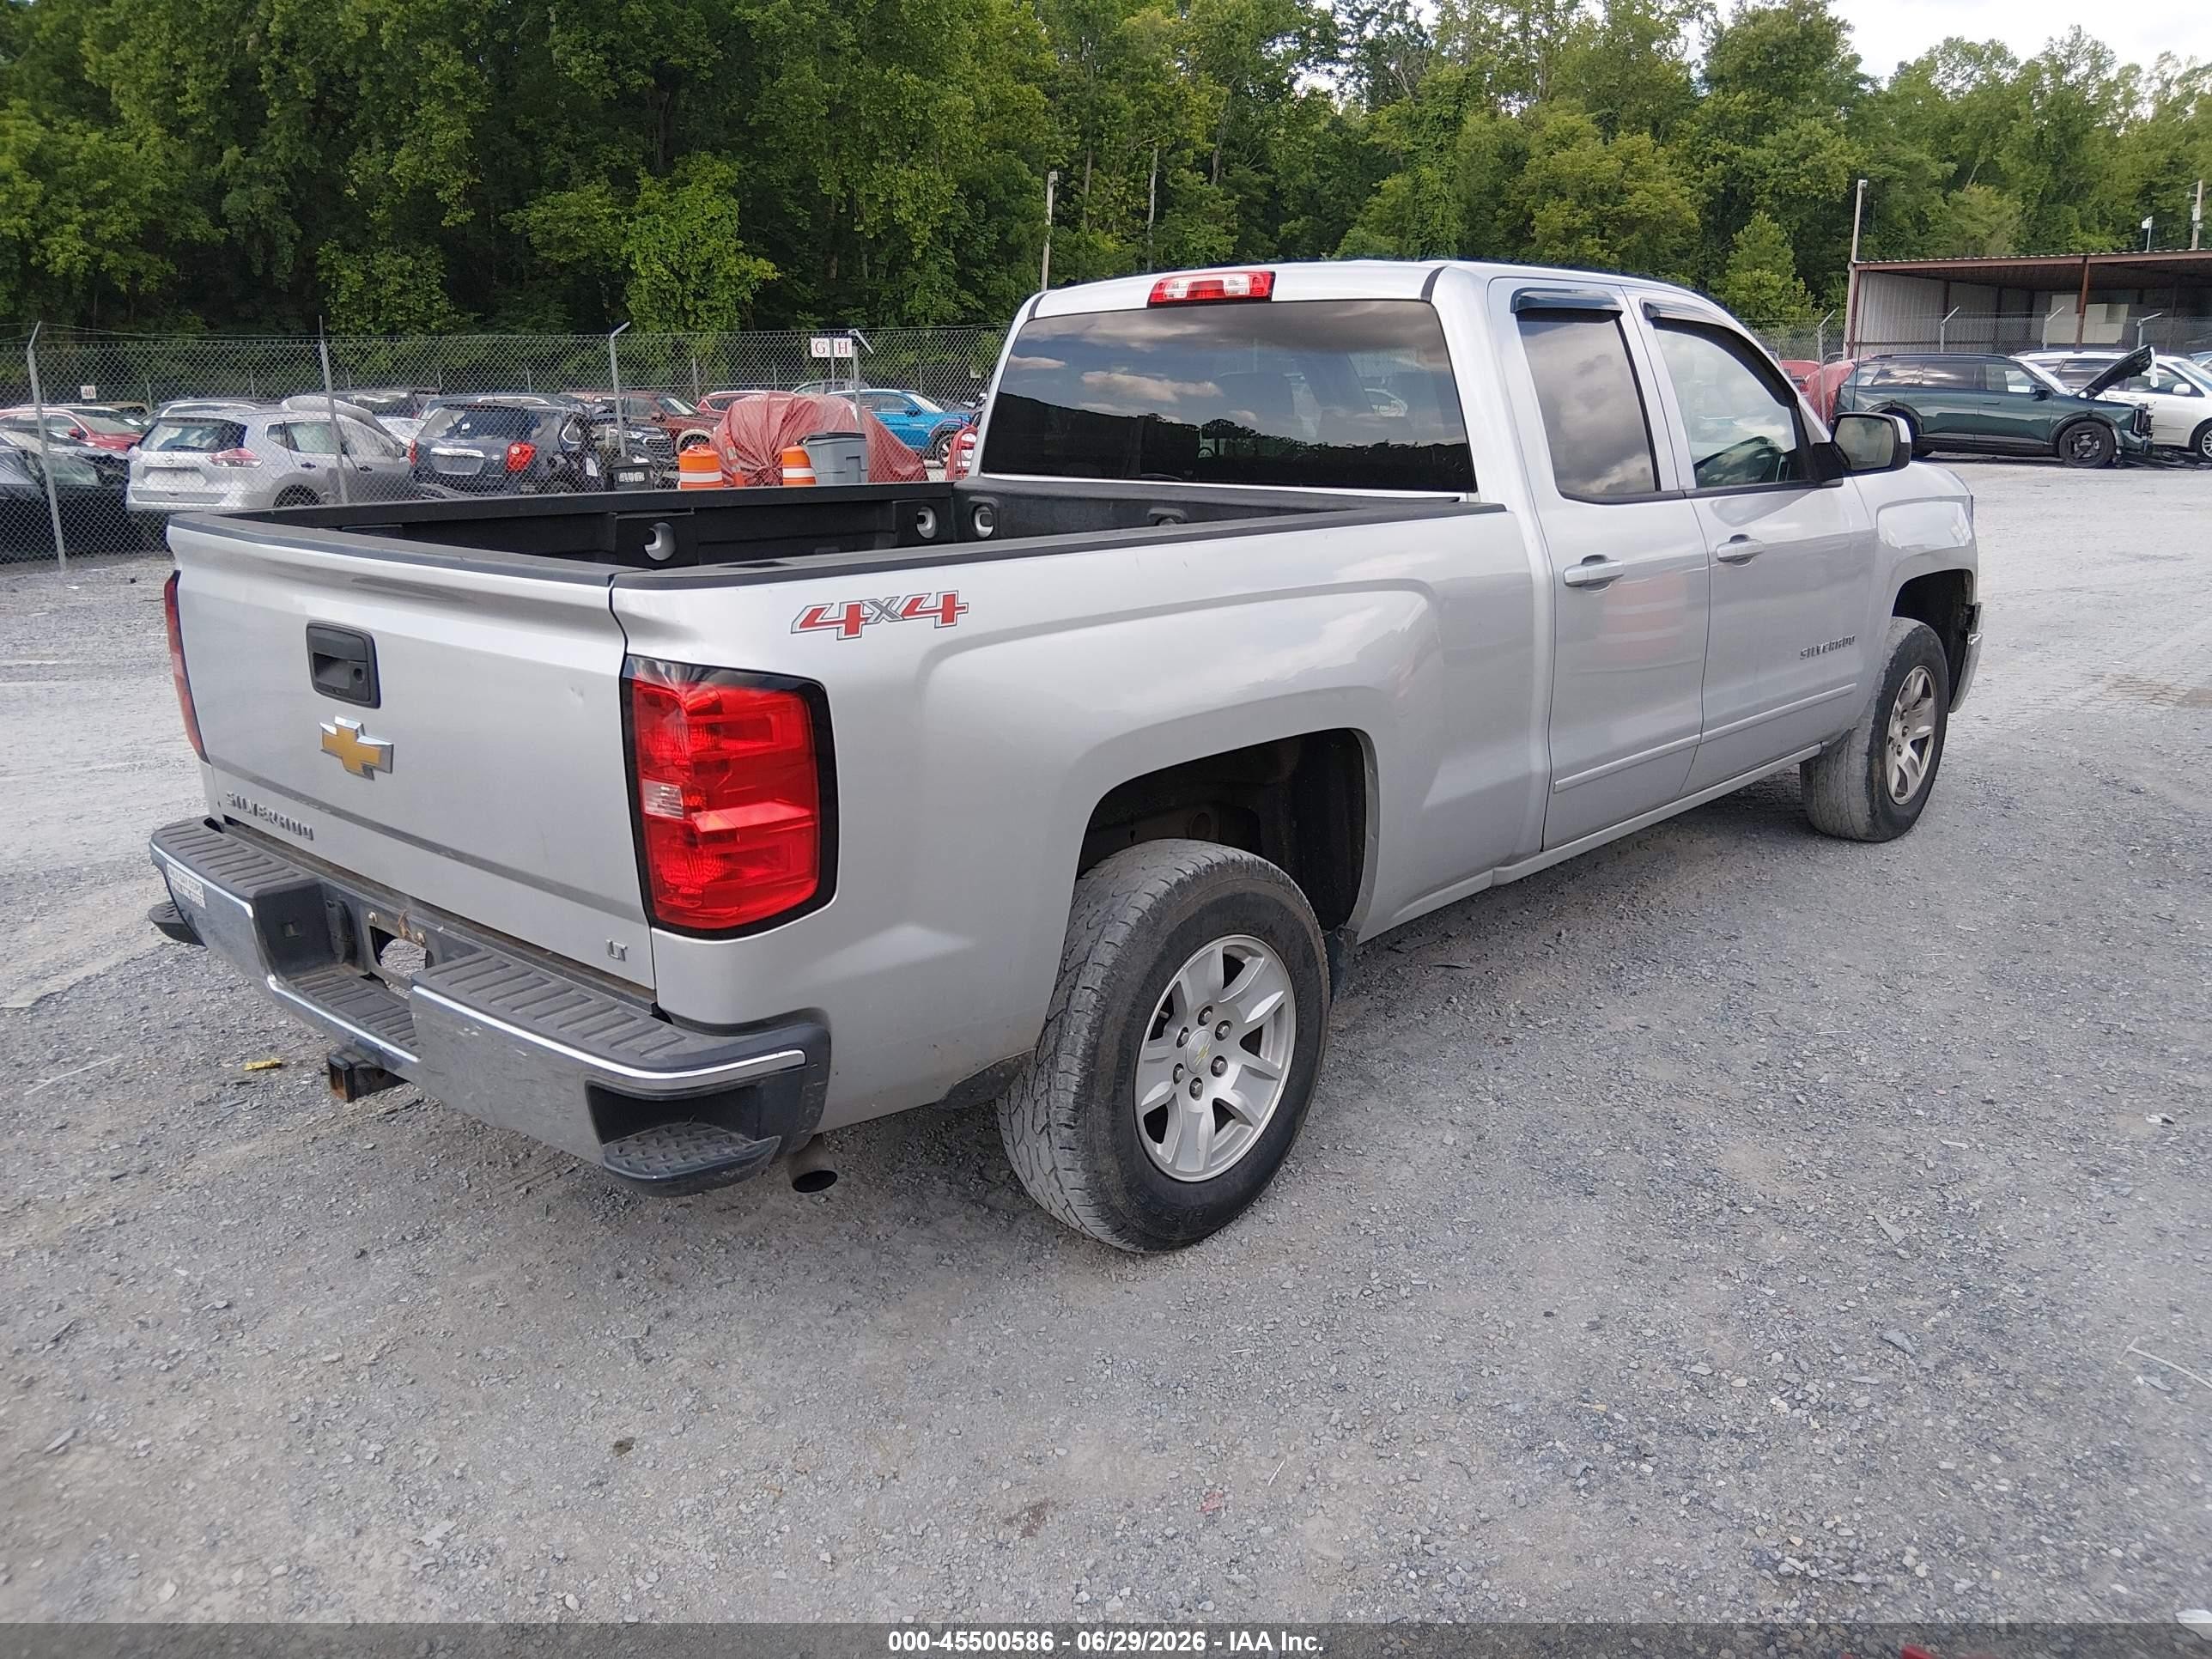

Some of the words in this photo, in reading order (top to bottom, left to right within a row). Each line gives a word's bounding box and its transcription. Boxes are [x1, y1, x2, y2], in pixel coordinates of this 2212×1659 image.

[815, 341, 826, 354] G
[838, 341, 848, 354] H
[1799, 634, 1856, 660] SILVERADO
[225, 789, 315, 842] SILVERADO
[606, 939, 628, 962] LT
